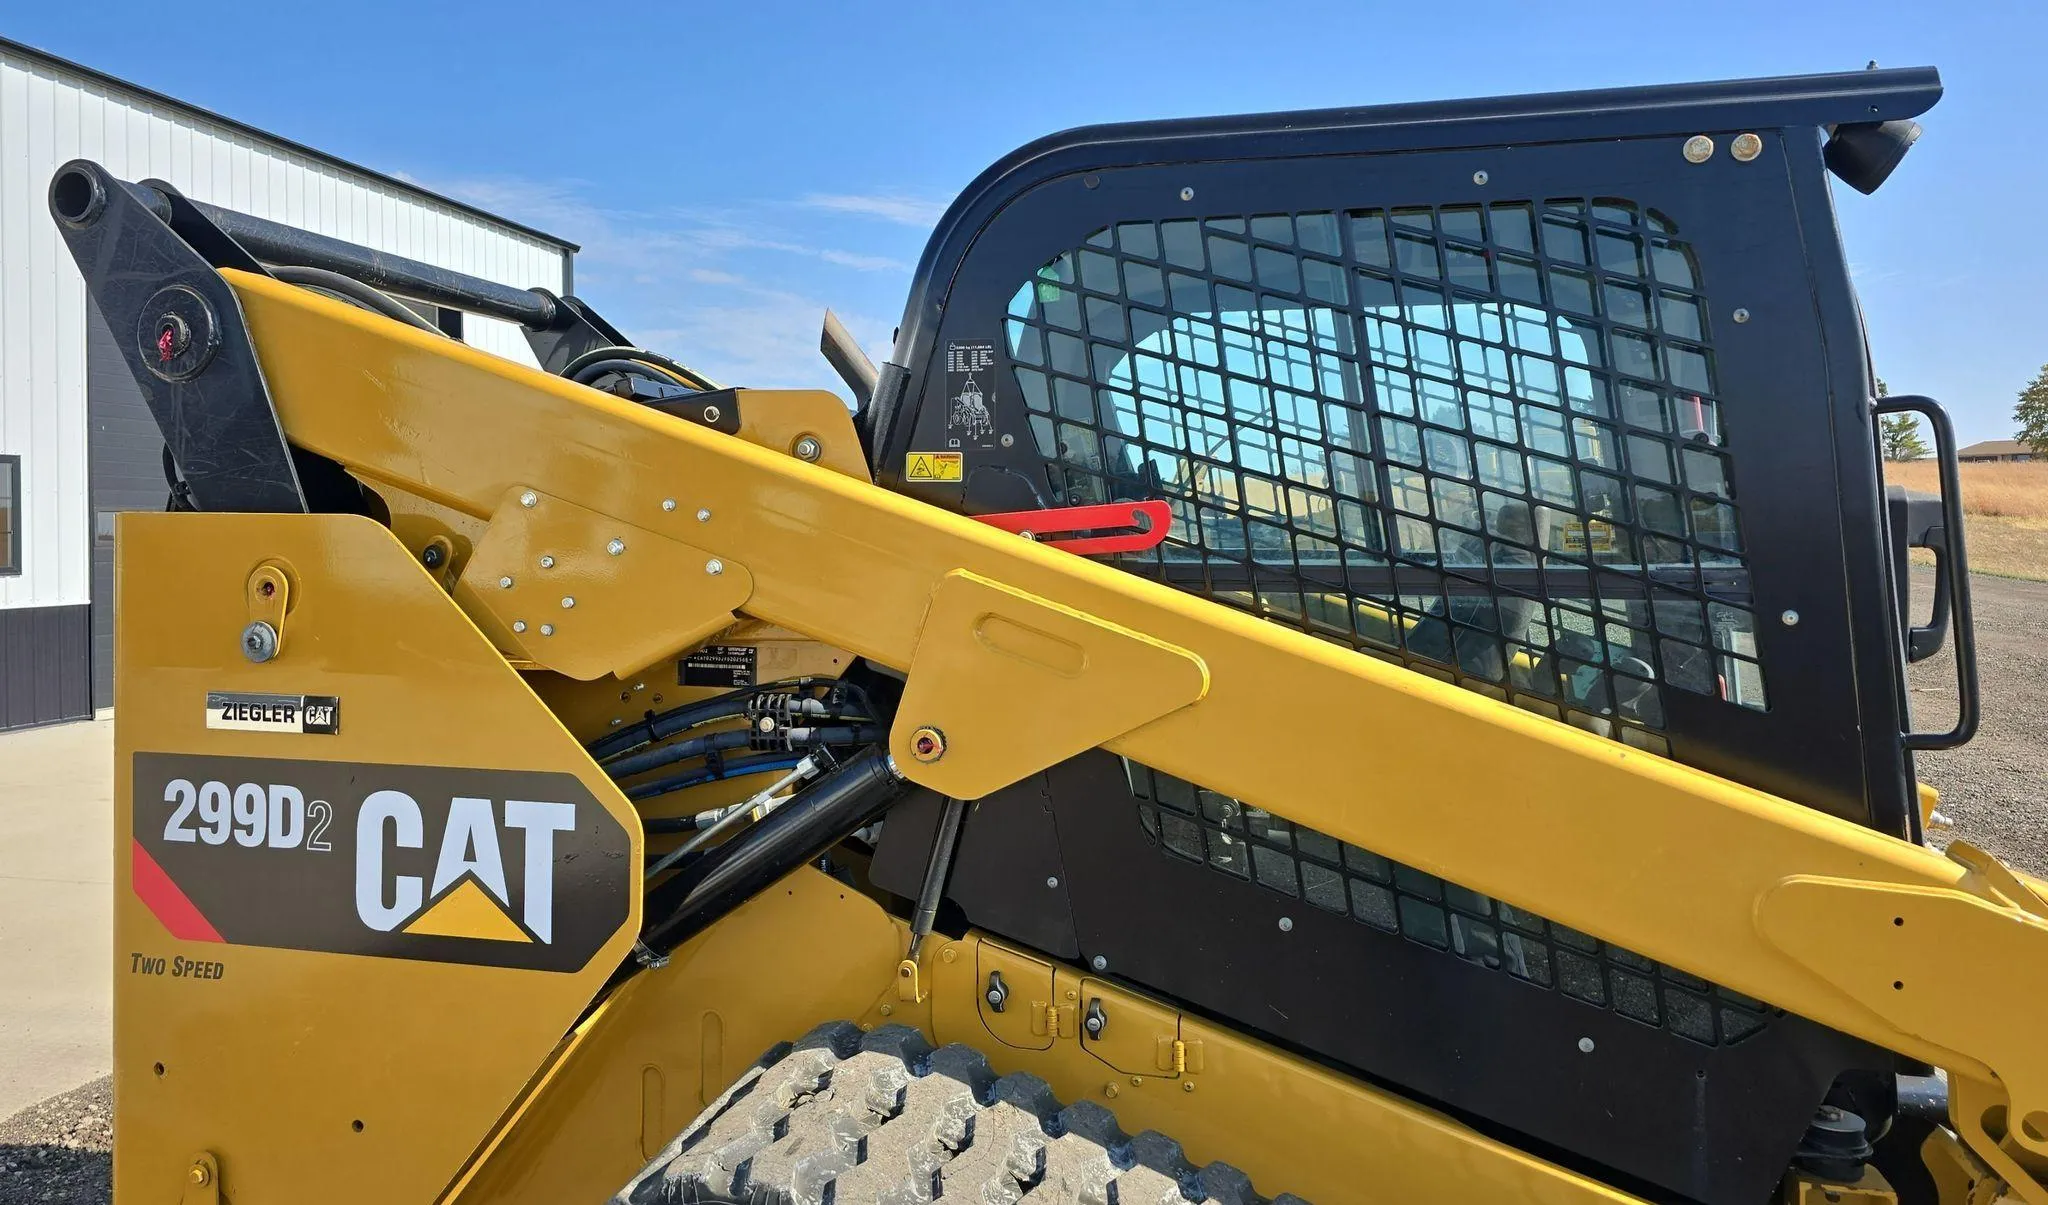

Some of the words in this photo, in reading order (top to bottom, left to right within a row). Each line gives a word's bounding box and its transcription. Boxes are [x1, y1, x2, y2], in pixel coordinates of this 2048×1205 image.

[221, 702, 295, 724] ZIEGLER
[305, 705, 334, 726] CAT
[163, 778, 333, 852] 299D2
[355, 789, 577, 945] CAT
